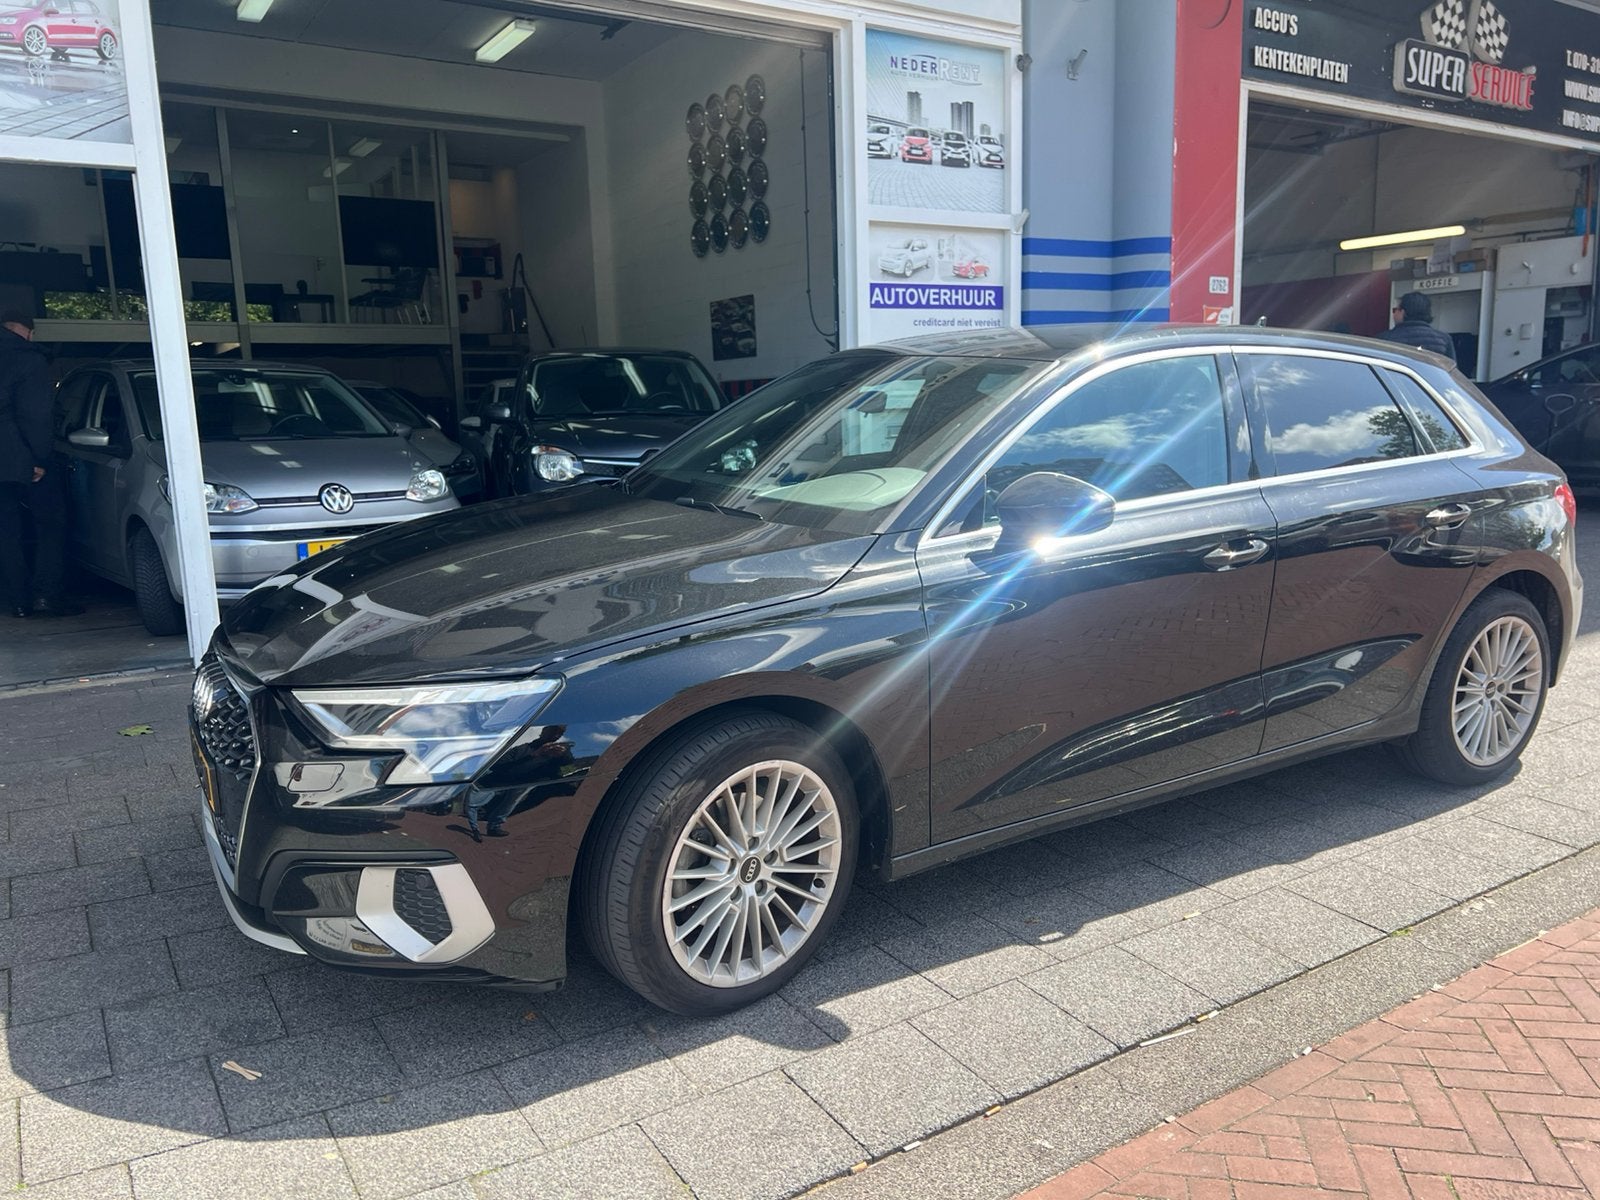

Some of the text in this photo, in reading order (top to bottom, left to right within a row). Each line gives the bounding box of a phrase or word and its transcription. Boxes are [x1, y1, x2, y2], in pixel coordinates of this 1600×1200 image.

[1254, 7, 1298, 36] ACCU'S
[1254, 46, 1349, 83] KENTEKENPLATEN
[1406, 47, 1536, 109] SUPER SERVICE
[1419, 277, 1453, 289] KOFFIE
[871, 287, 996, 306] AUTOVERHUUR
[913, 317, 1001, 328] creditcard niet vereist
